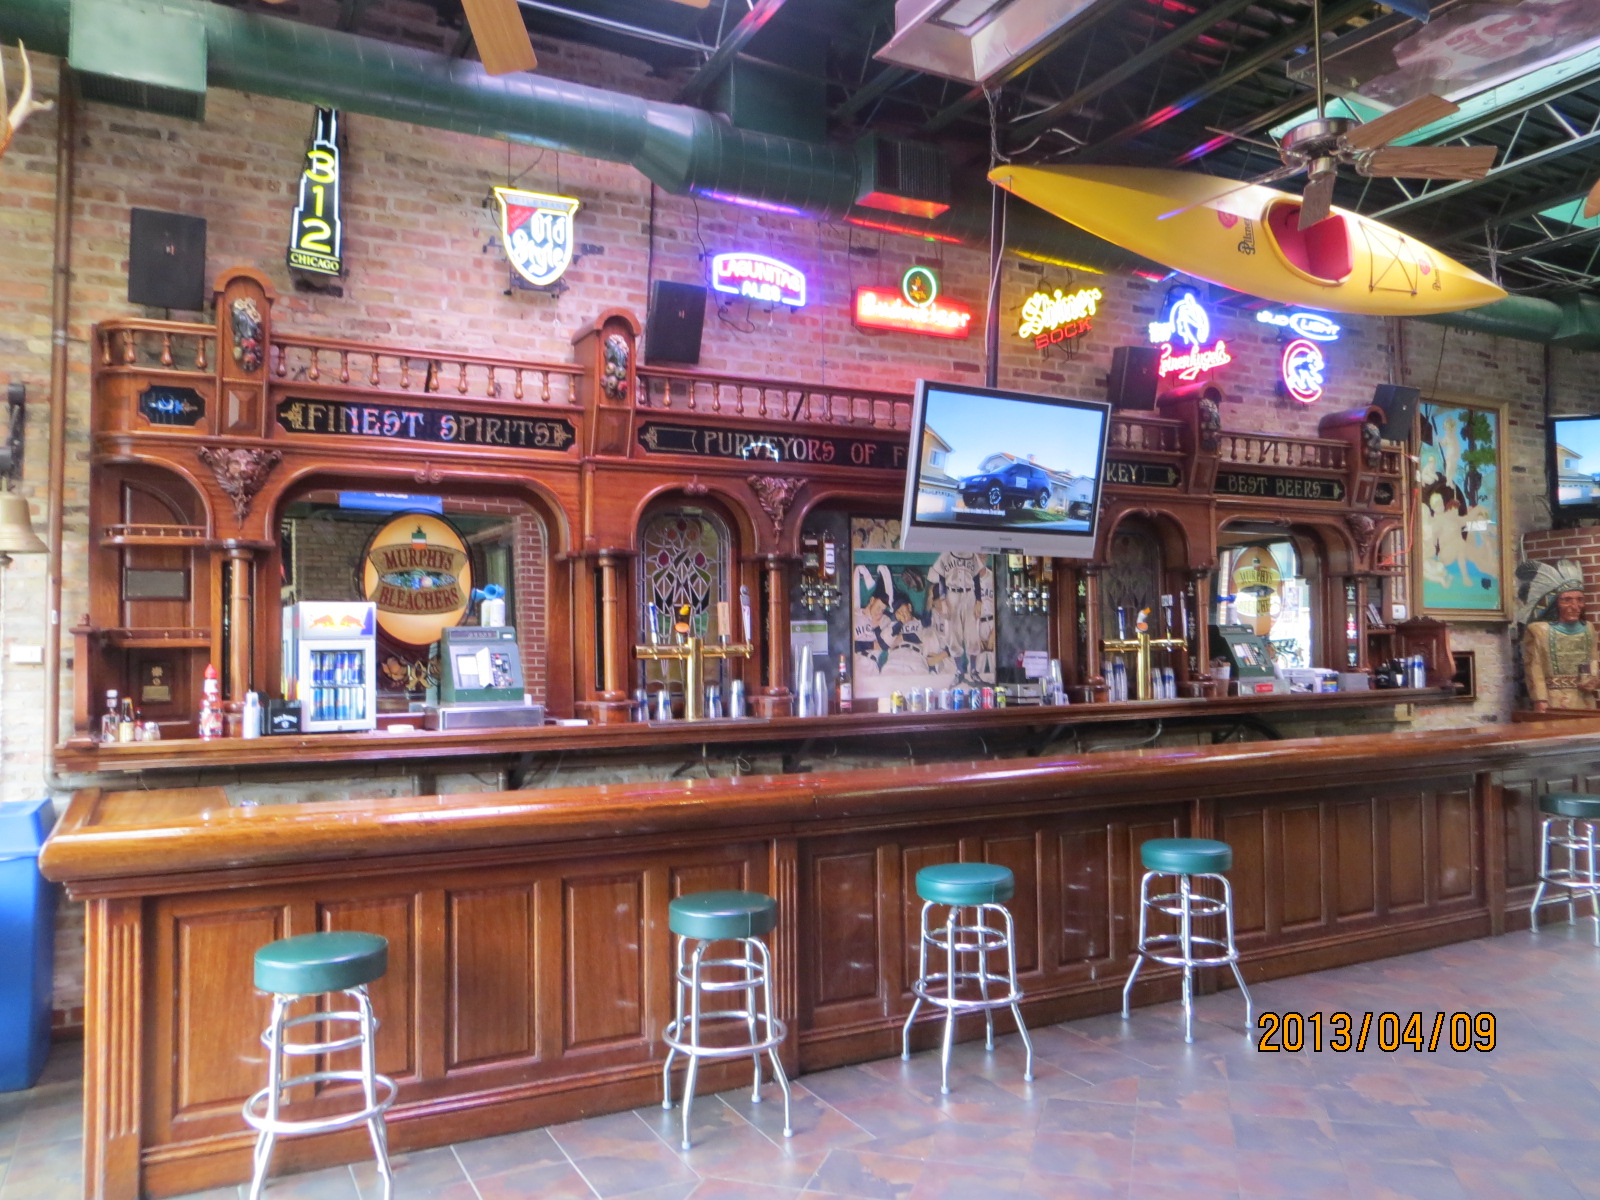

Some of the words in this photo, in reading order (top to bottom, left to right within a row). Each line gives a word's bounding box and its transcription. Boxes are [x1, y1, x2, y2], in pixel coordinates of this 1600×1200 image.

[300, 150, 336, 254] 312
[530, 209, 566, 245] Old
[290, 252, 340, 272] CHICAGO
[510, 228, 565, 276] Style
[741, 280, 782, 302] ALES
[1019, 287, 1103, 338] Shiner
[1035, 316, 1093, 350] BOCK
[307, 404, 424, 438] FINEST
[440, 415, 550, 446] SPIRITS
[704, 430, 835, 462] PURVEYORS
[850, 442, 876, 465] OF
[1228, 474, 1268, 495] BEST
[1276, 478, 1322, 499] BEERS
[944, 559, 976, 573] CHICAGO
[380, 586, 459, 611] BLEACHERS
